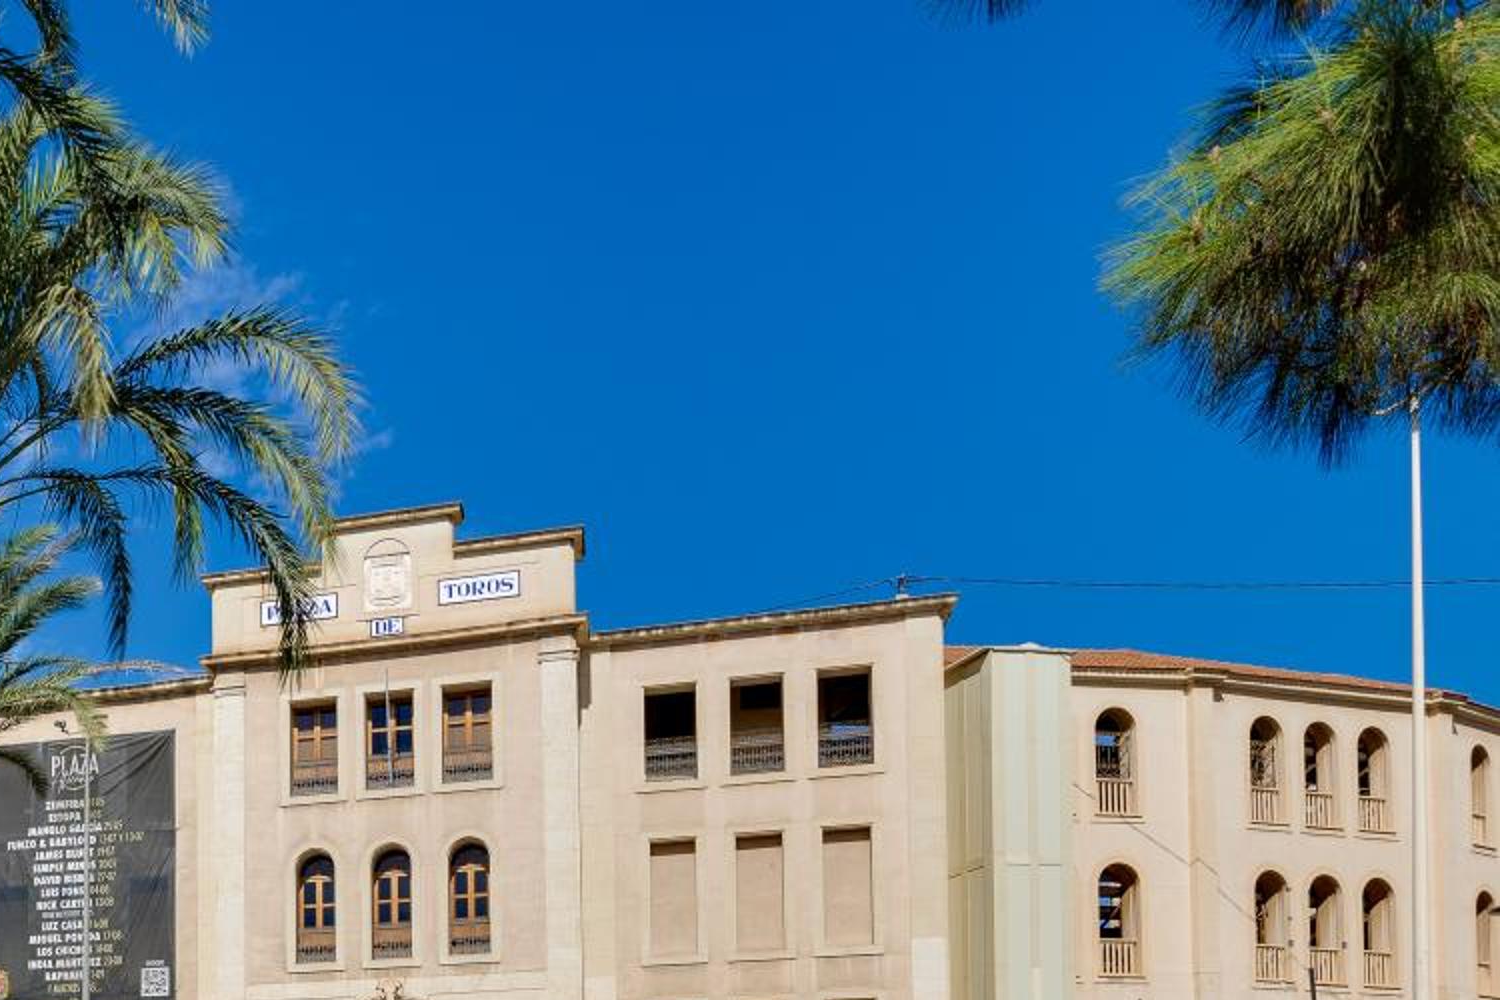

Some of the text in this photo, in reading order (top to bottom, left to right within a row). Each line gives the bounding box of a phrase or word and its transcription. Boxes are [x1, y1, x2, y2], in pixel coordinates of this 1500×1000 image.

[444, 577, 515, 599] TOROS
[266, 599, 332, 621] PAZA
[375, 619, 400, 634] DE
[51, 752, 99, 777] PLAZA
[66, 848, 95, 859] BLUT
[67, 861, 97, 871] MINS
[63, 873, 95, 884] BISBL
[61, 886, 84, 897] FONS
[61, 919, 83, 931] CASA
[65, 932, 101, 943] POVDA
[56, 957, 101, 968] MARTEZ
